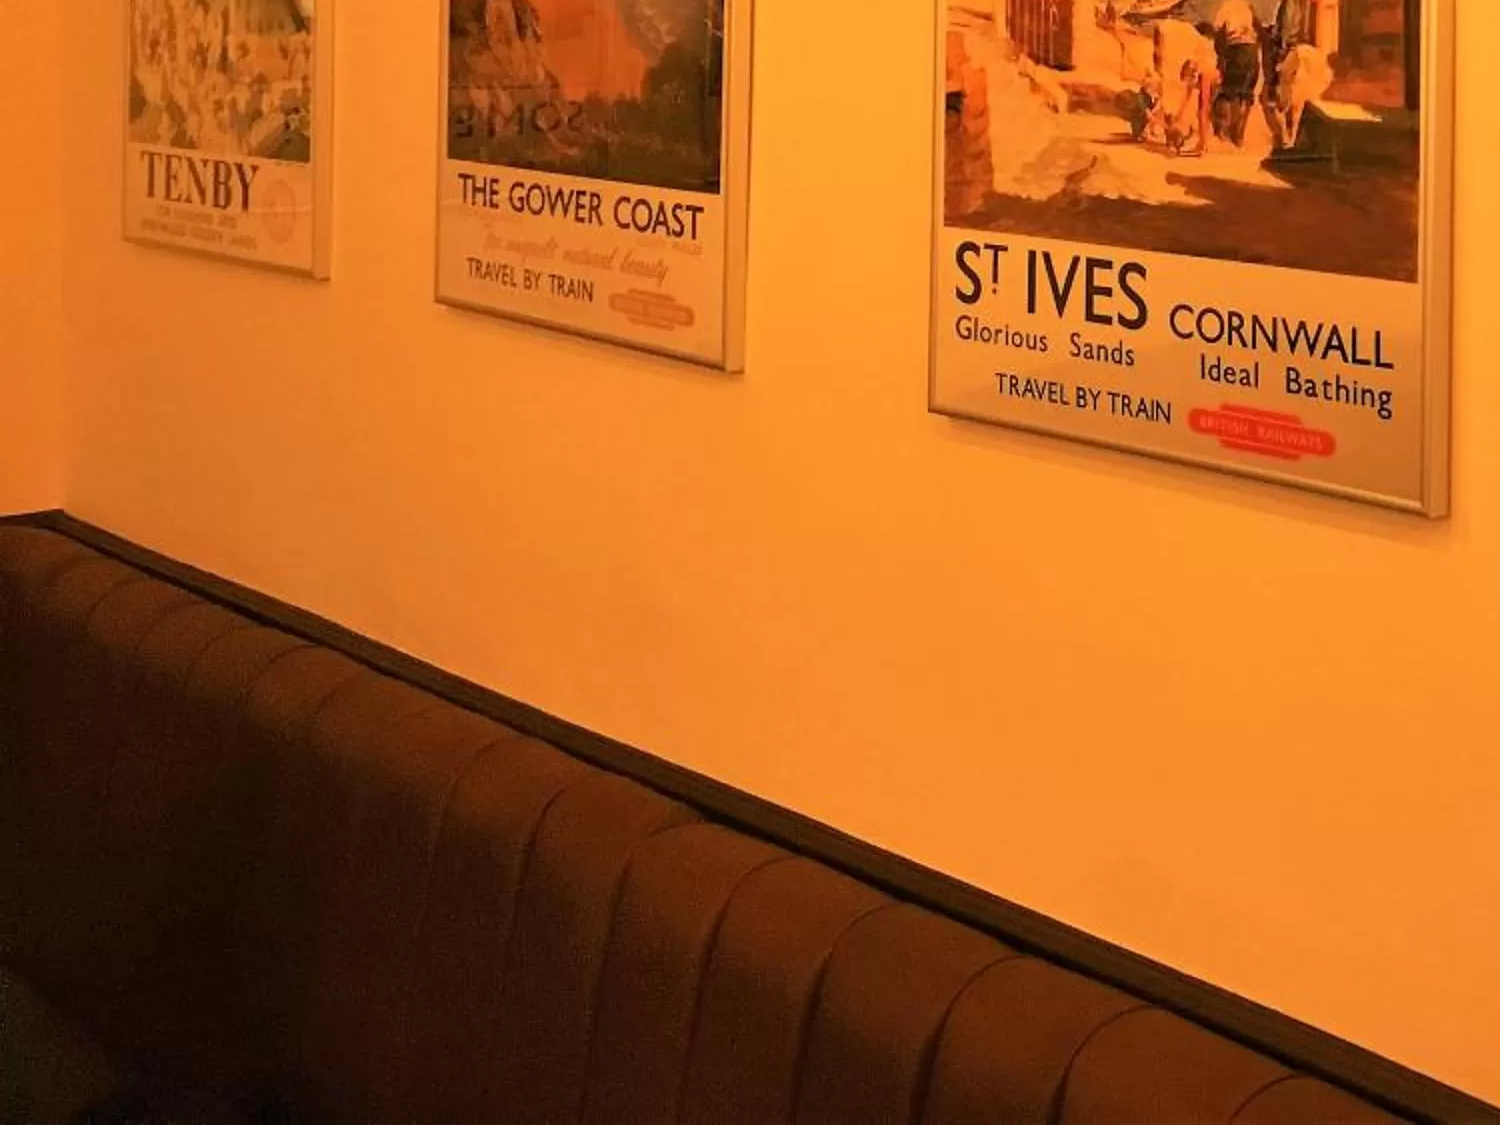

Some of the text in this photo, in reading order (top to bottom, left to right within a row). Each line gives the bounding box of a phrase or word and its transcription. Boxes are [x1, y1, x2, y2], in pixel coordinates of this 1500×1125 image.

[140, 150, 259, 212] TENBY
[458, 173, 704, 240] THE GOWER COAST
[467, 257, 594, 303] TRAVEL BY TRAIN
[1027, 250, 1148, 330] IVES
[1169, 304, 1394, 369] CORNWALL
[955, 315, 1392, 419] Glorious Sands Ideal Bathing
[995, 373, 1171, 424] TRAVEL BY TRAIN
[1257, 425, 1323, 453] RAILWAYS
